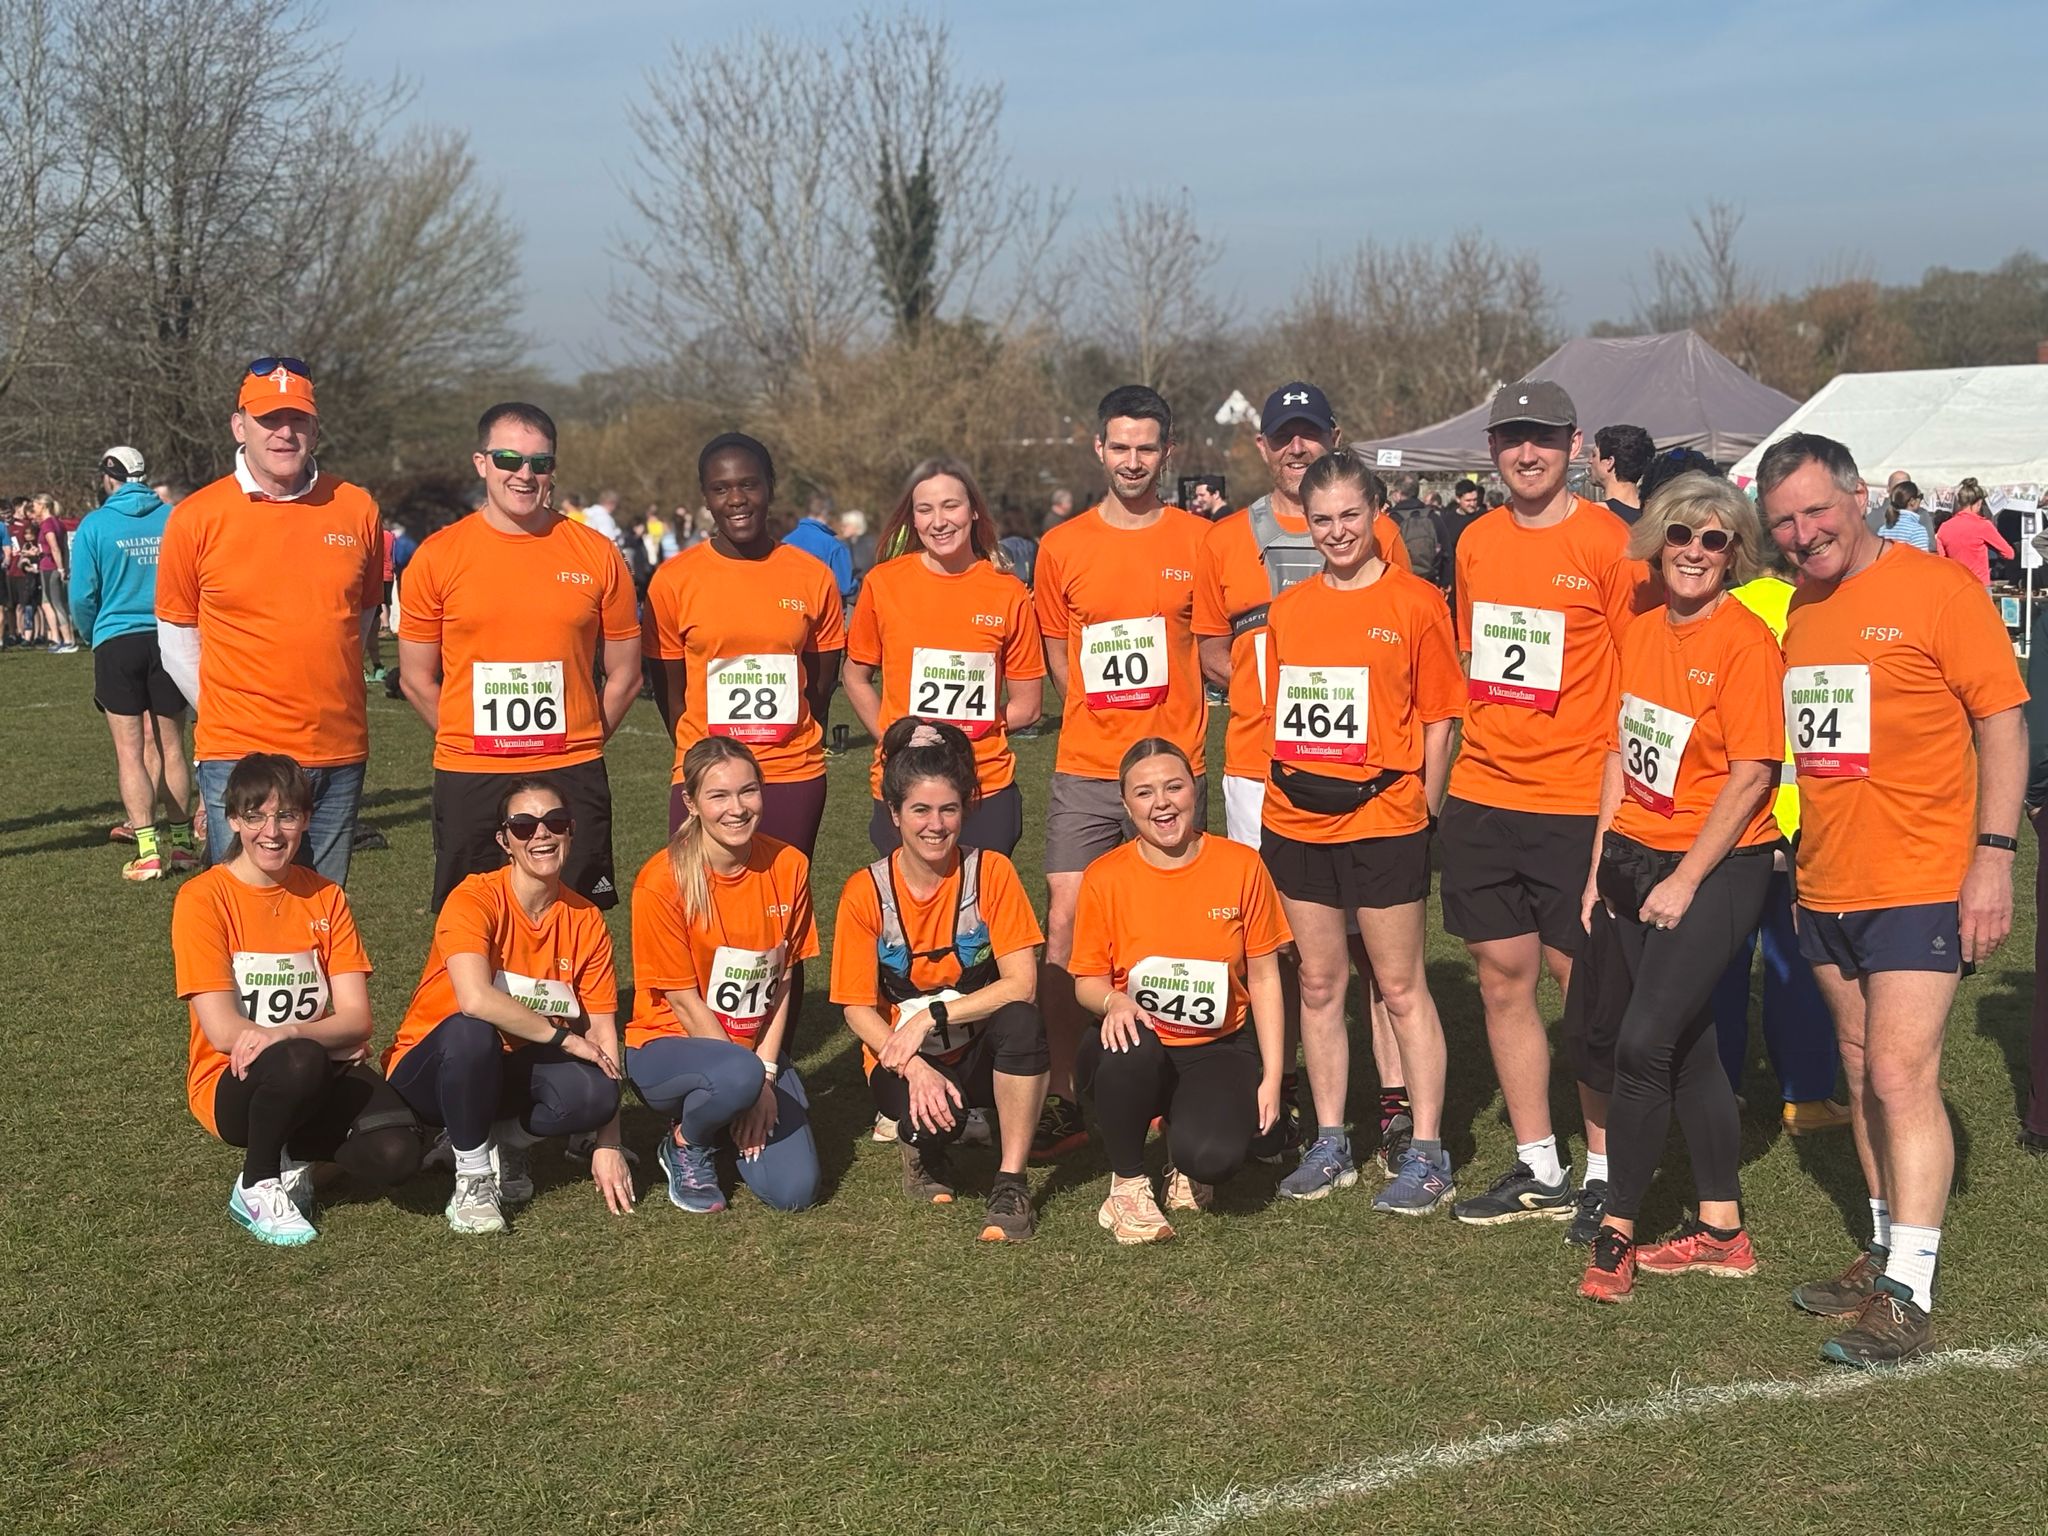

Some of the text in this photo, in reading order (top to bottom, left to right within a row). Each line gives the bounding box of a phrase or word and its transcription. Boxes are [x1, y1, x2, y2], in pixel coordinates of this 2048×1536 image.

[116, 537, 162, 548] WALLINGF
[328, 533, 355, 547] FSP
[560, 571, 590, 585] FSP
[1165, 568, 1191, 582] FSP
[1556, 573, 1588, 590] FSP
[782, 598, 806, 612] FSP
[975, 614, 1003, 627] FSP
[1371, 627, 1399, 645] FSP
[1484, 623, 1552, 645] GORING 10K
[1865, 626, 1900, 642] FSP
[1090, 636, 1155, 654] GORING 10K
[1102, 652, 1149, 687] 40
[1501, 644, 1526, 682] 2
[719, 672, 787, 685] GORING 10K
[923, 666, 986, 682] GORING 10K
[485, 681, 552, 695] GORING 10K
[1287, 686, 1355, 701] GORING 10K
[1488, 685, 1536, 701] Warmingham
[1791, 688, 1855, 704] GORING 10K
[728, 687, 778, 720] 28
[917, 681, 987, 716] 274
[482, 697, 557, 732] 106
[1283, 703, 1359, 739] 464
[1623, 715, 1654, 741] GORING
[1655, 729, 1675, 749] 10K
[1797, 707, 1842, 749] 34
[1295, 744, 1343, 756] Warmingham
[1627, 737, 1660, 784] 36
[1212, 907, 1239, 920] FSP
[245, 971, 318, 986] GORING 10K
[725, 966, 768, 980] GORING
[1141, 975, 1215, 994] GORING 10K
[241, 986, 319, 1024] 195
[550, 1000, 570, 1013] 10K
[1135, 989, 1216, 1026] 643
